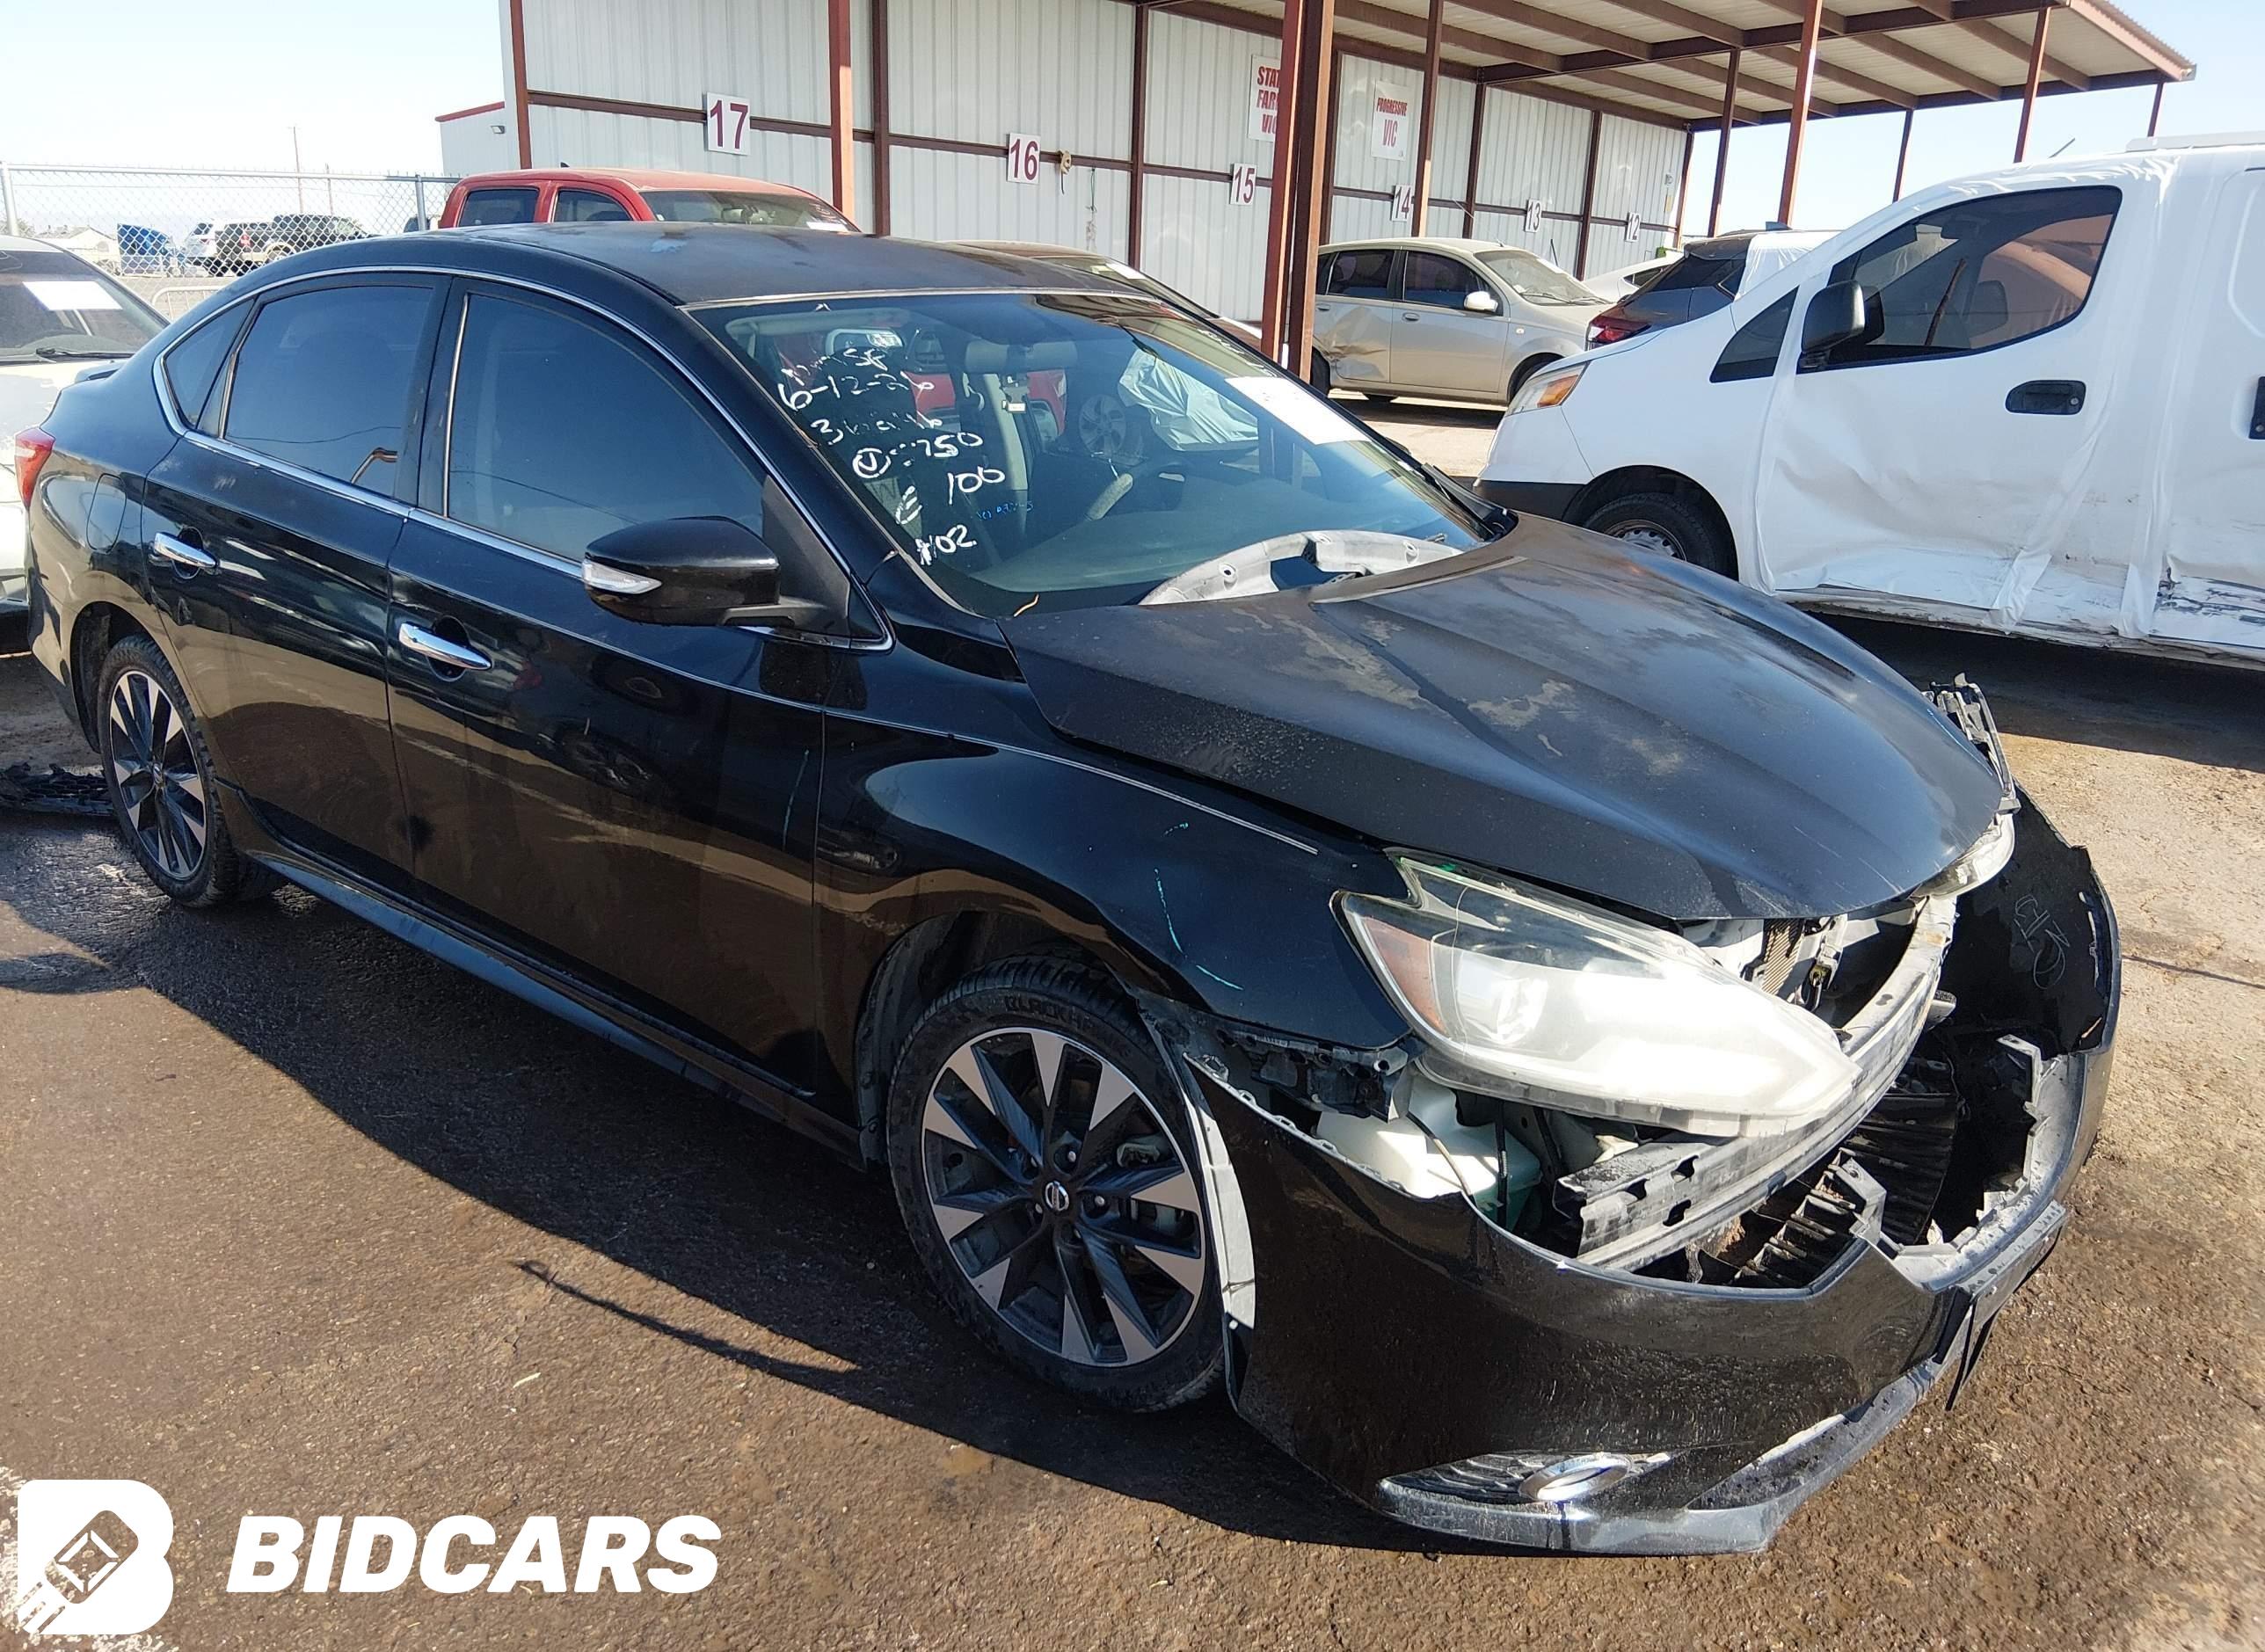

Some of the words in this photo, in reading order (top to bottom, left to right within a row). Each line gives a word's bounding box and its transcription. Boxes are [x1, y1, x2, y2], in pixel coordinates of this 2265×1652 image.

[1257, 65, 1281, 88] STAT
[710, 99, 748, 149] 17
[1383, 119, 1398, 148] VIC
[1010, 138, 1038, 181] 16
[1234, 166, 1256, 204] 15
[1395, 186, 1411, 219] 14
[1527, 200, 1541, 232] 13
[1628, 213, 1641, 240] 12
[947, 466, 1006, 506] 100
